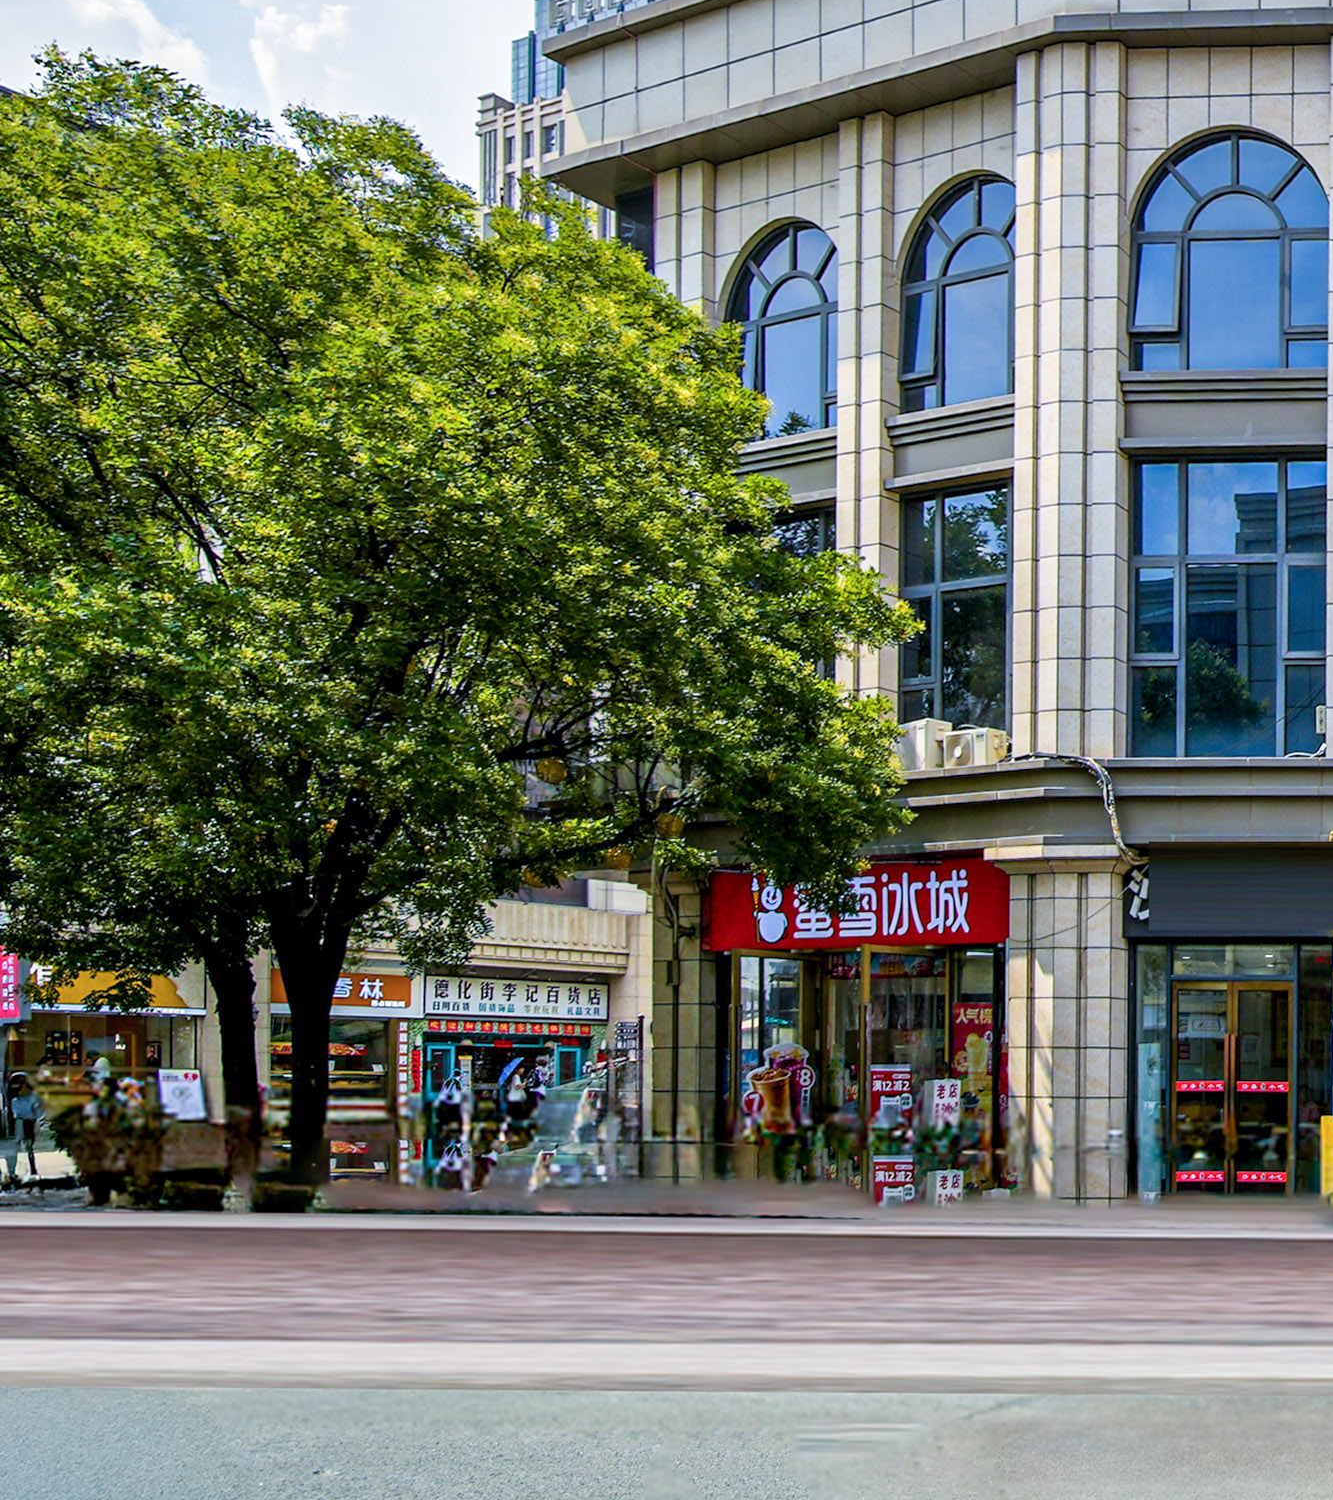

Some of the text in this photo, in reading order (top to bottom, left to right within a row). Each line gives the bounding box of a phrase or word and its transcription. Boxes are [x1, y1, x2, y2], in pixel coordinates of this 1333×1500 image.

[434, 979, 601, 1006] 德化街李记百货店
[800, 1069, 811, 1086] 8
[937, 1084, 961, 1099] 老店
[939, 1175, 963, 1190] 老店
